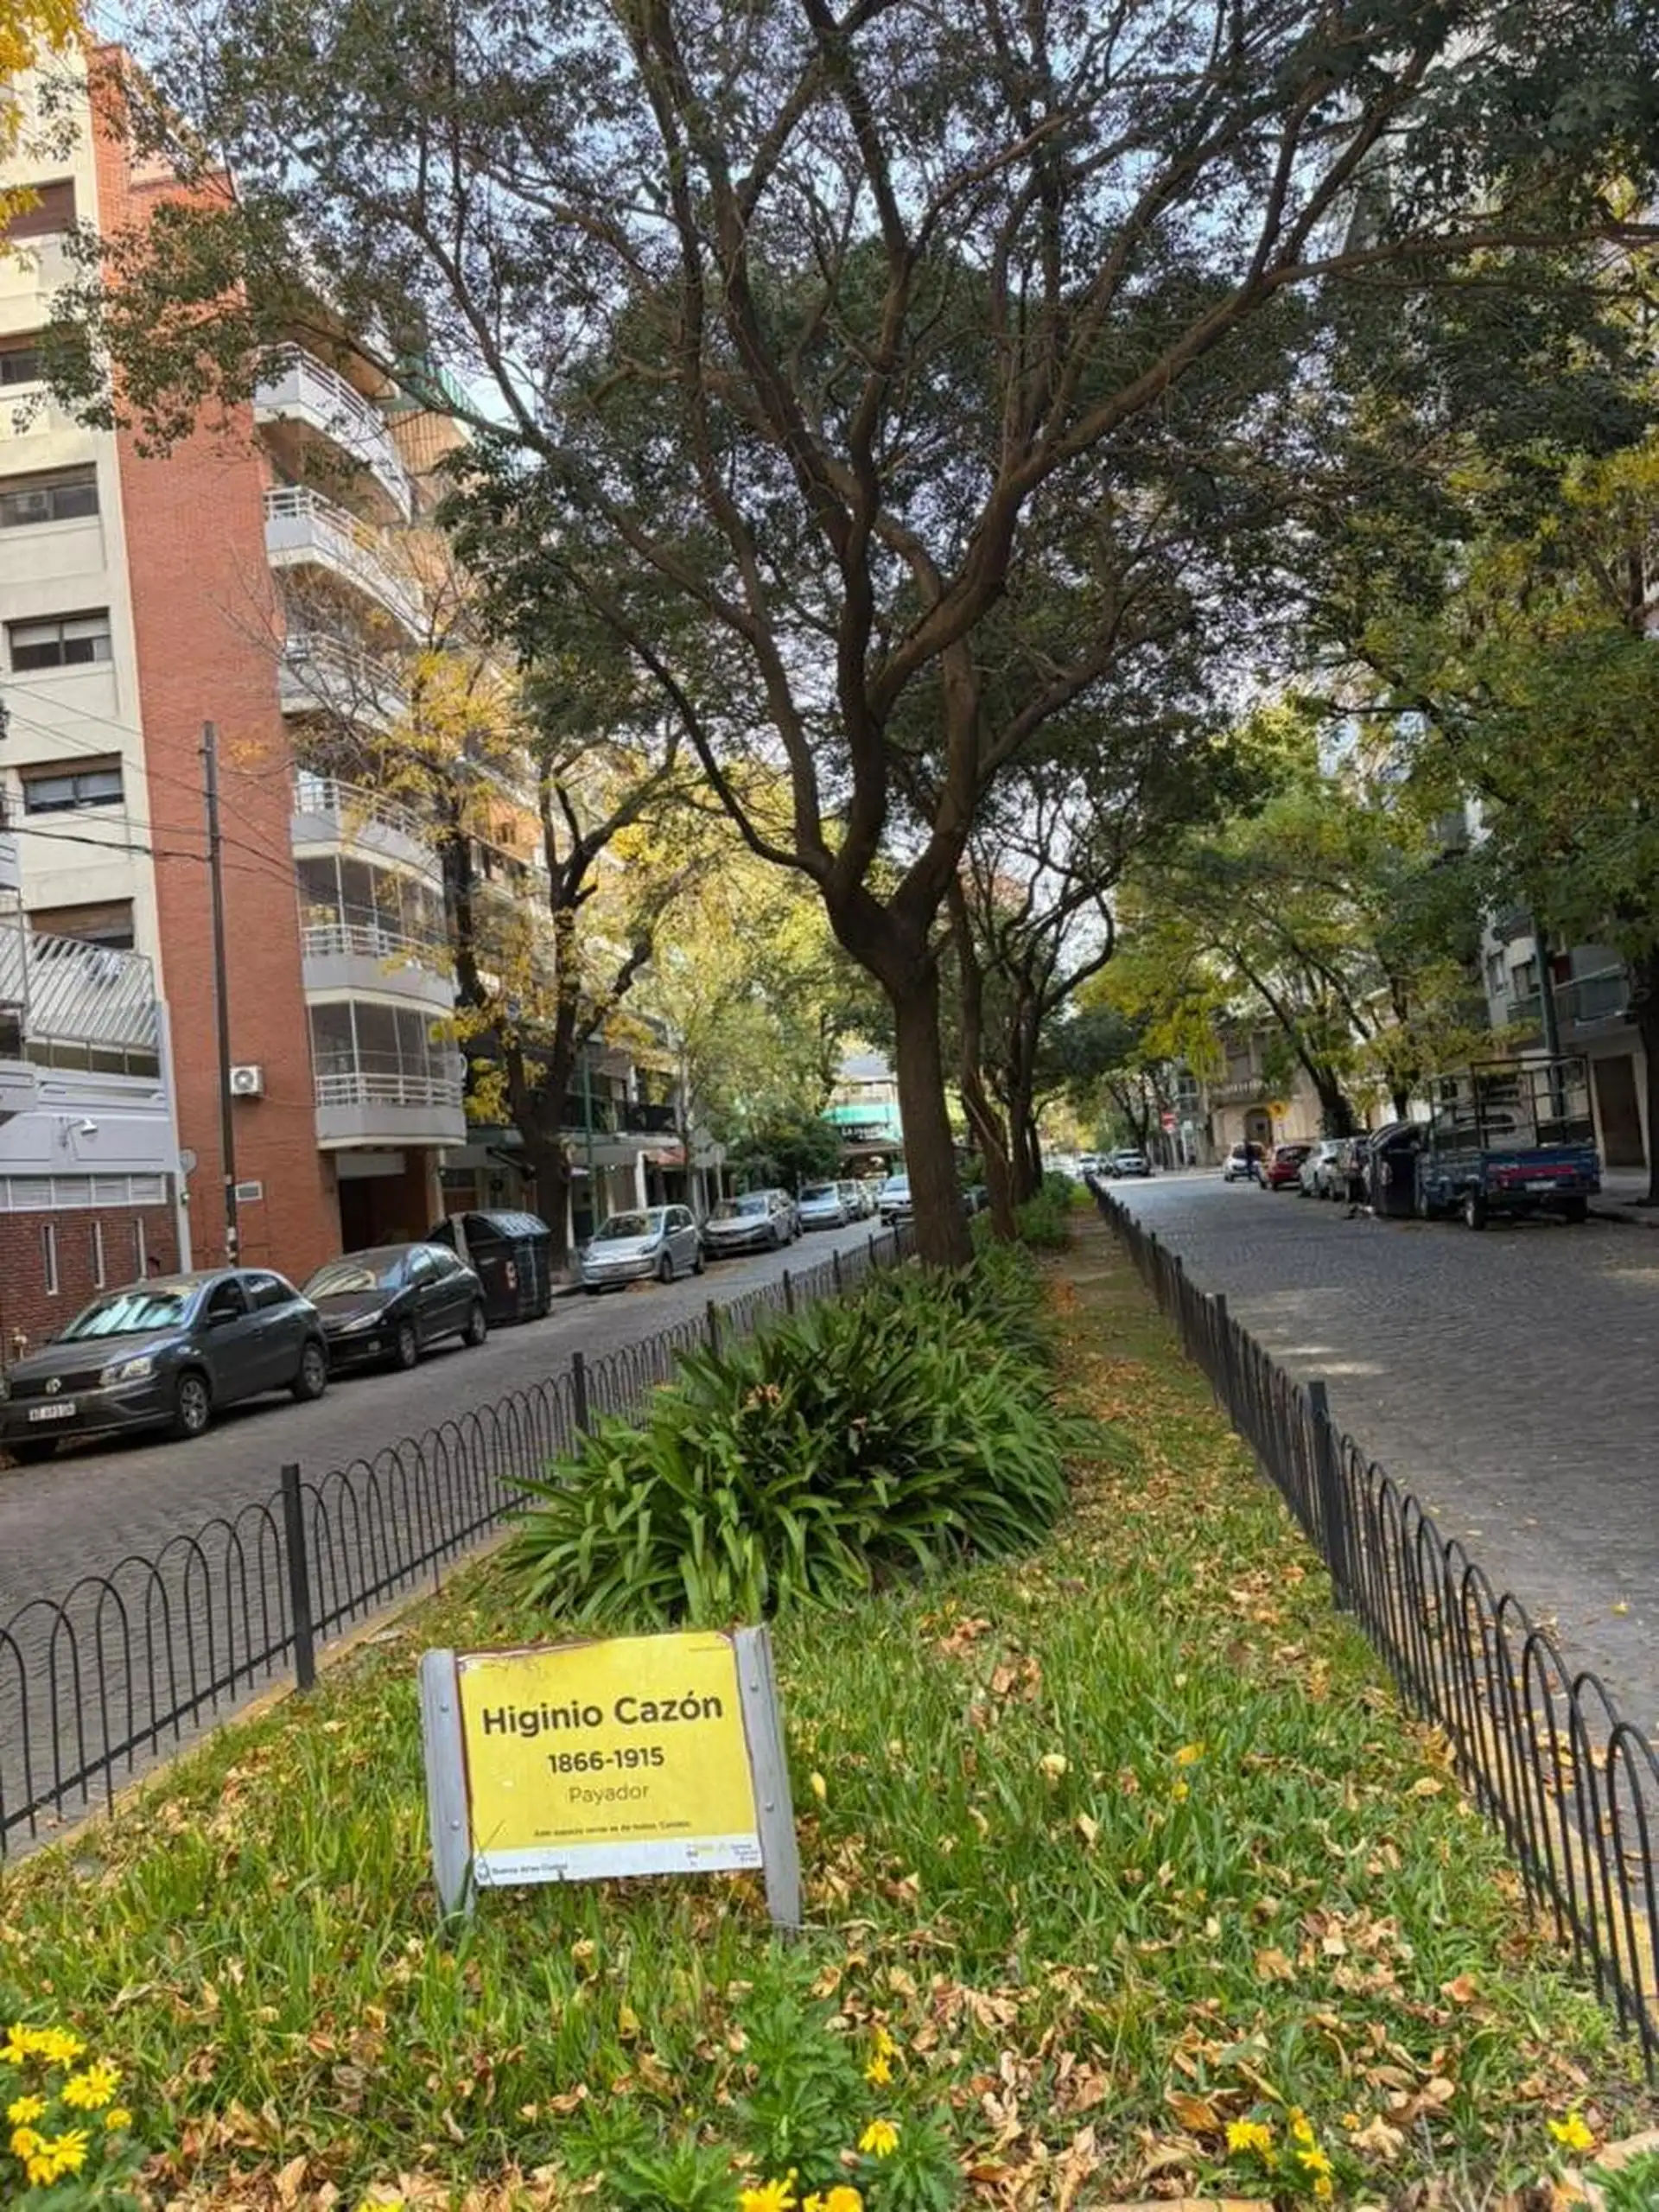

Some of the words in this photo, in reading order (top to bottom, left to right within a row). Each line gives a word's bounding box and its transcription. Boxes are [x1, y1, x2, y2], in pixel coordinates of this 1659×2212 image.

[482, 1700, 604, 1738] Higinio
[614, 1690, 723, 1726] Cazón
[547, 1746, 665, 1774] 1866-1915
[569, 1783, 650, 1807] Payador
